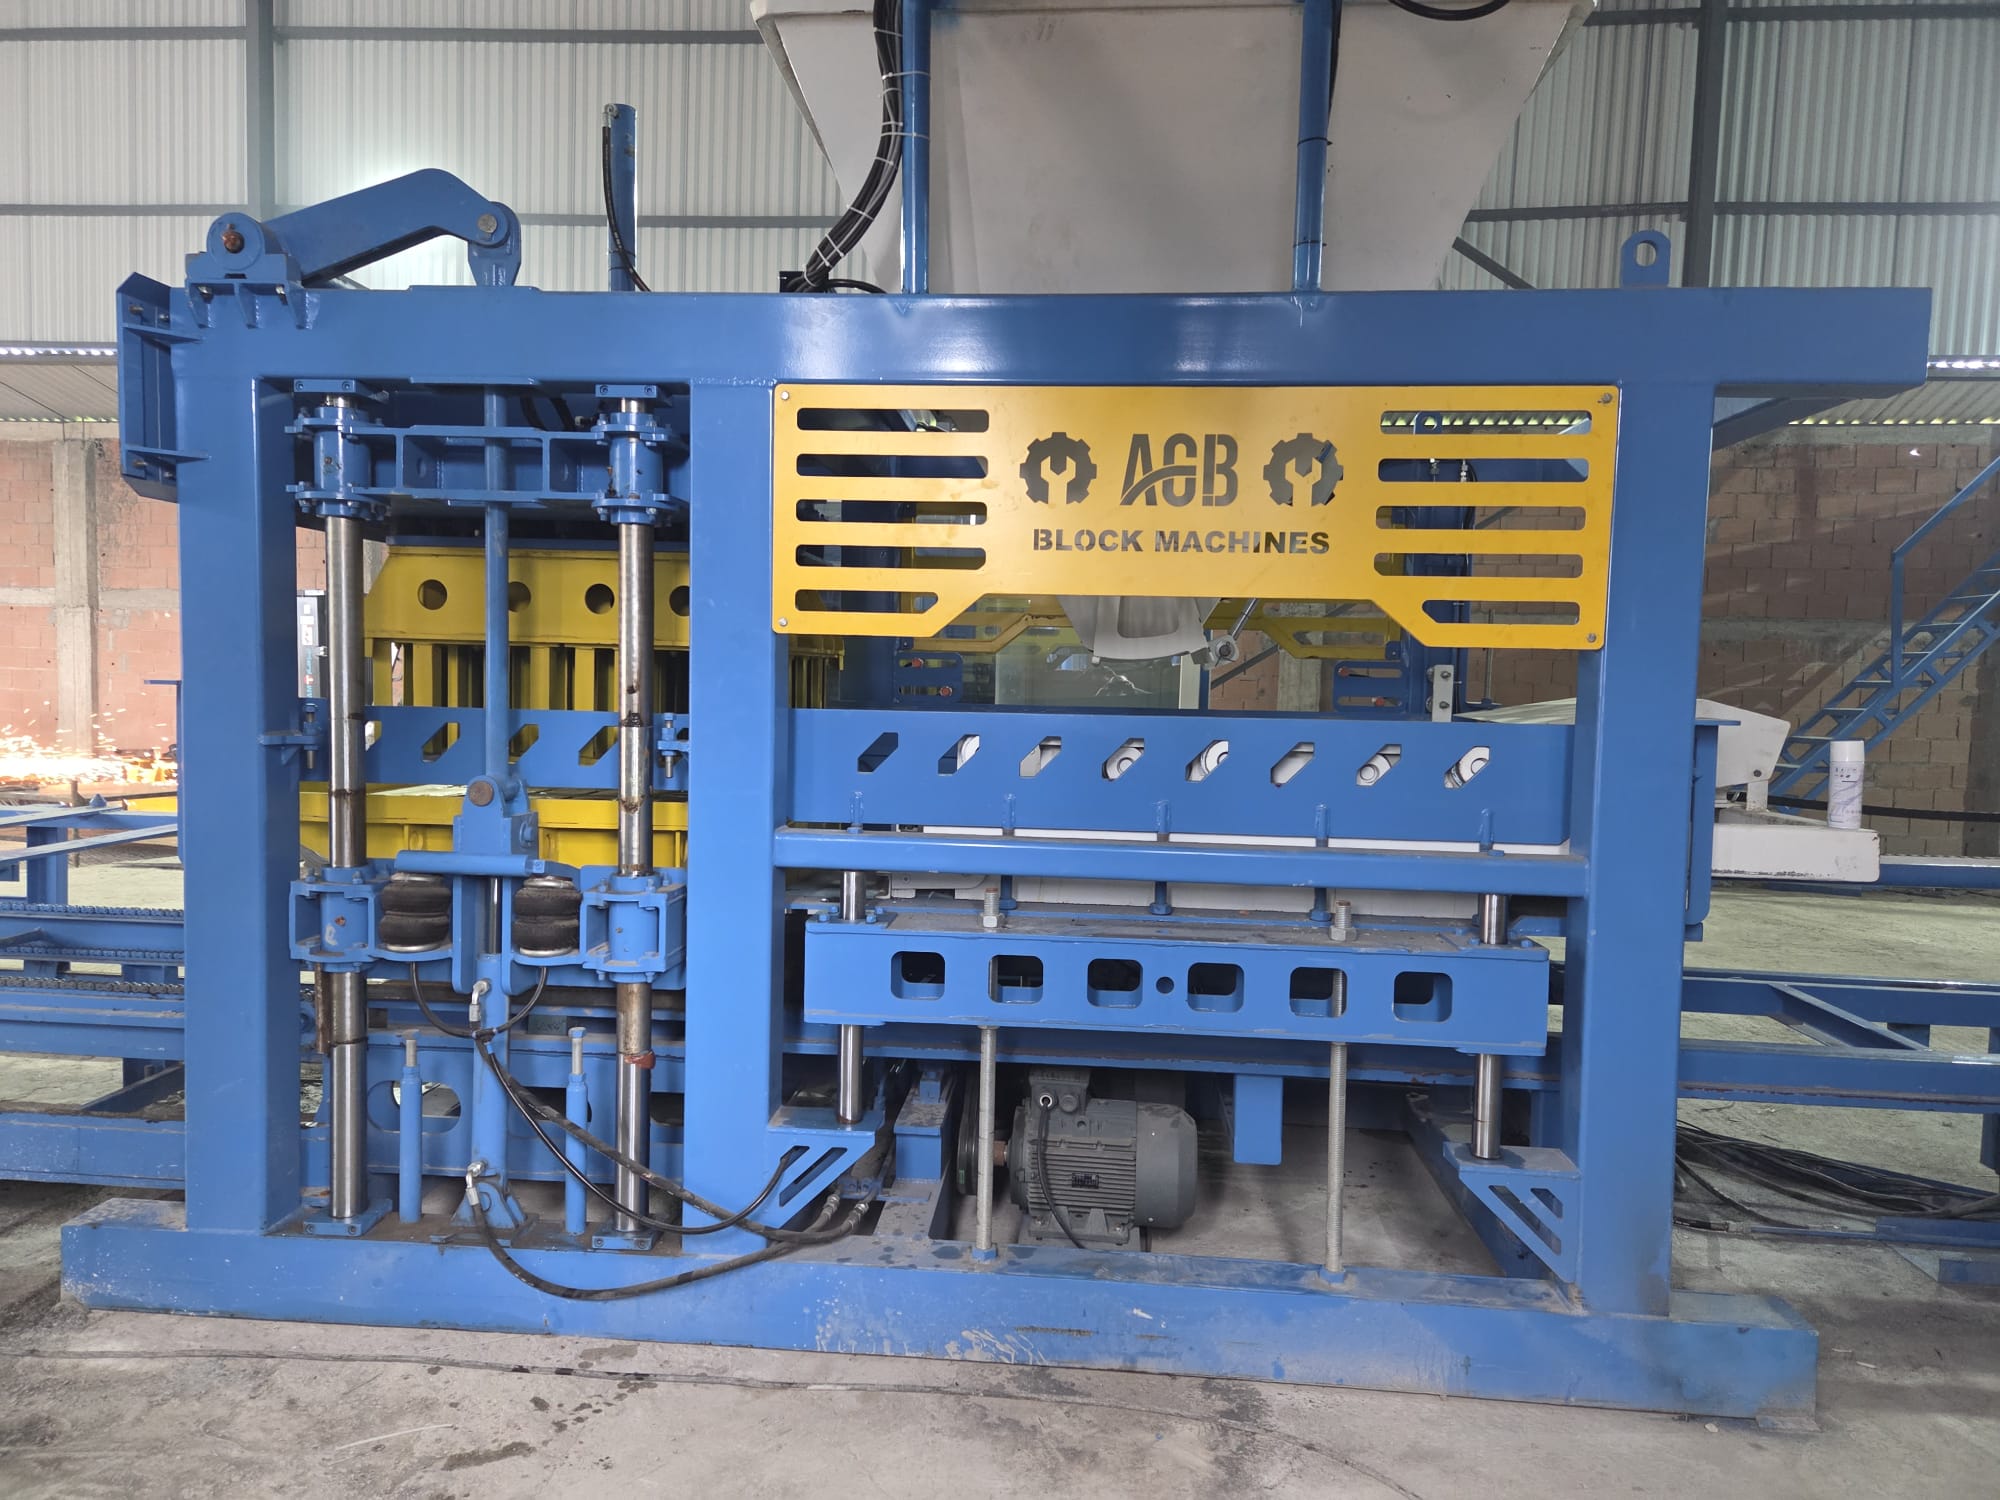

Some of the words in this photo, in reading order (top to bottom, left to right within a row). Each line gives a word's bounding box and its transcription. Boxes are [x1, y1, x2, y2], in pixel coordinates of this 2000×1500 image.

[1120, 433, 1238, 507] AGB
[1033, 528, 1143, 552] BLOCK
[1155, 531, 1330, 554] MACHINES
